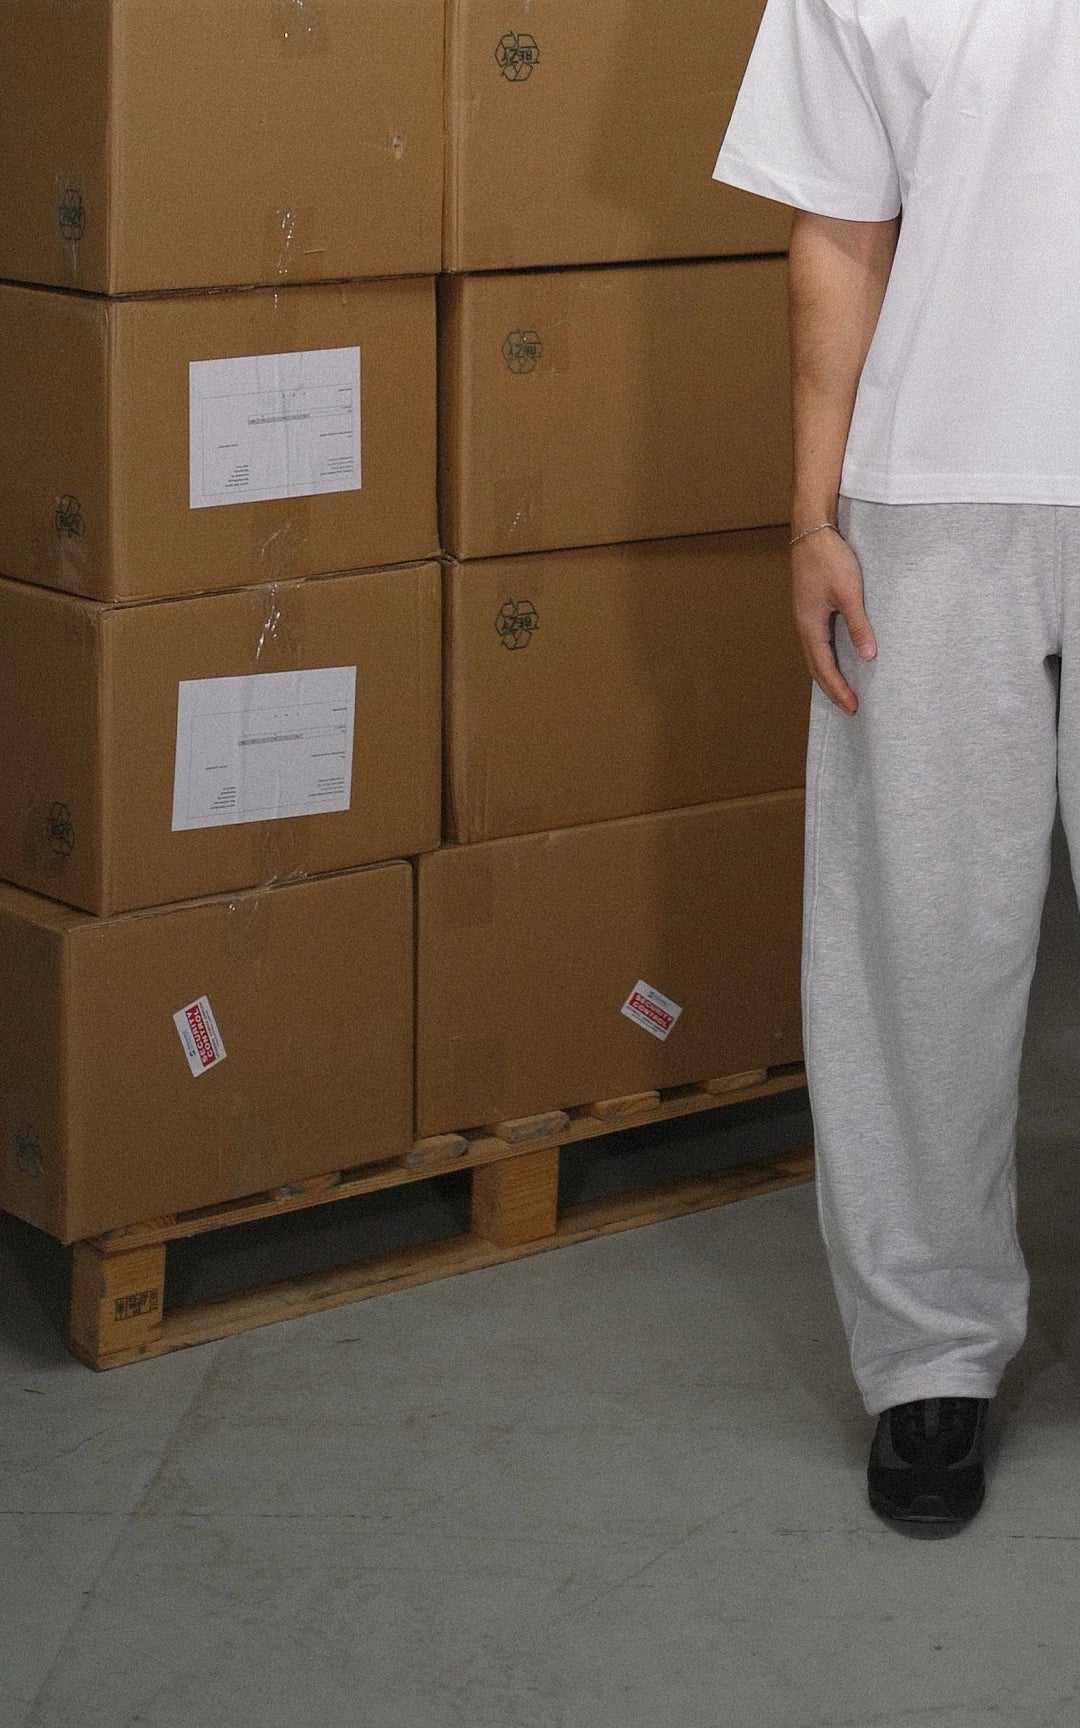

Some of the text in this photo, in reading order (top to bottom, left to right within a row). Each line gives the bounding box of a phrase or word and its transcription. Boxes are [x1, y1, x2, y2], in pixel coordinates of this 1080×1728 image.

[501, 48, 533, 63] REZY
[633, 1001, 668, 1029] CONTROL
[635, 994, 672, 1022] SECURITY
[187, 1012, 209, 1063] SECURITY
[195, 1008, 214, 1058] CONTROL
